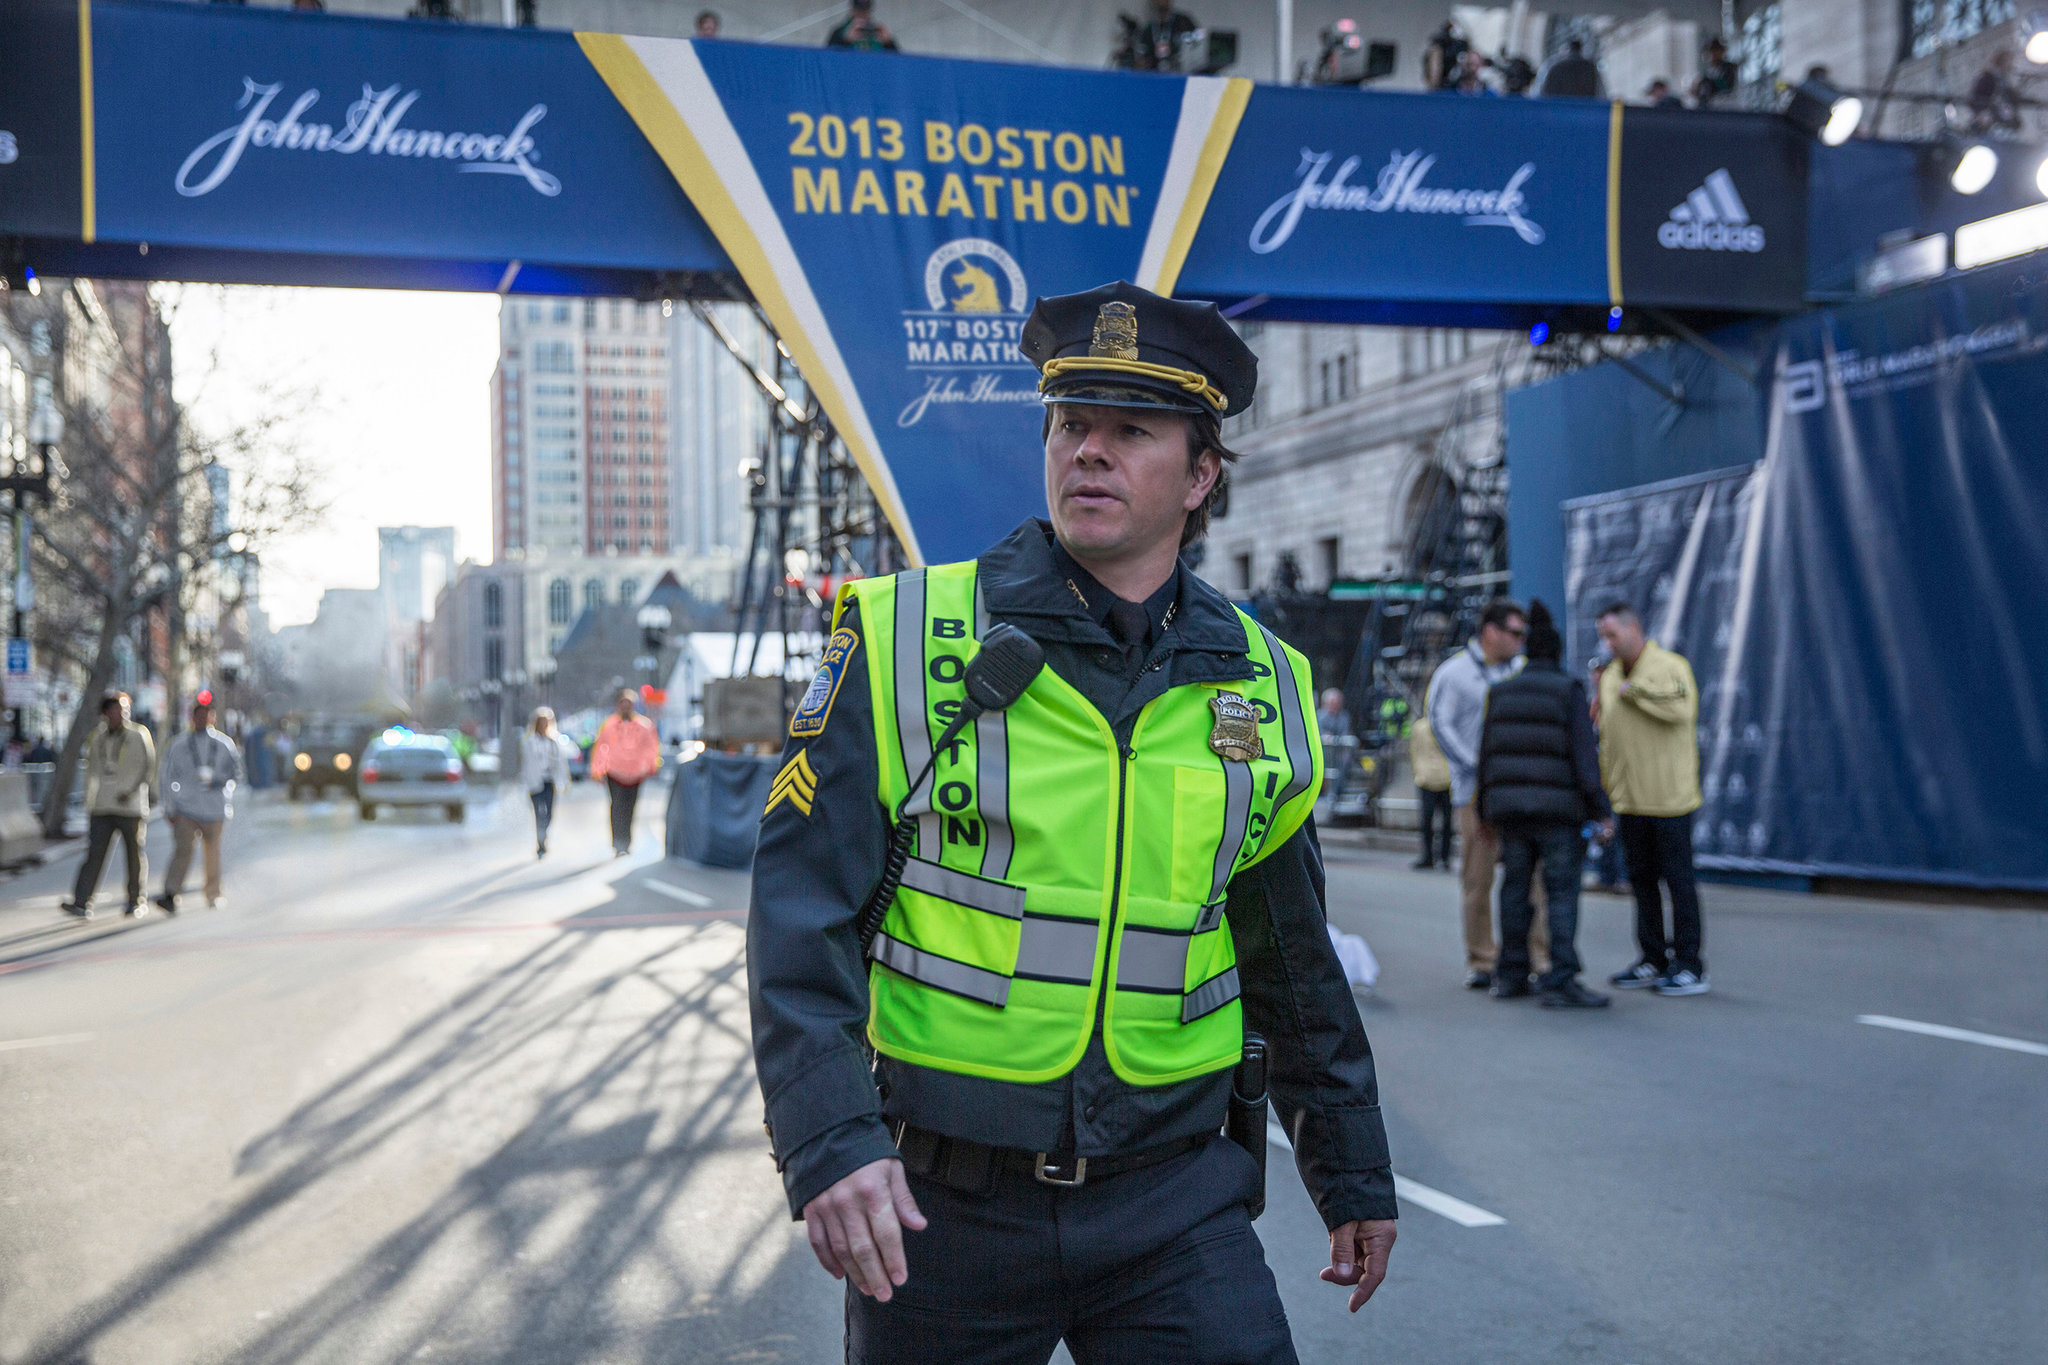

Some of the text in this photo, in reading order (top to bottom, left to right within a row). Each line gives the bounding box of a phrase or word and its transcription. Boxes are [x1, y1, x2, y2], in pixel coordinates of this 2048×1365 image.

[174, 76, 563, 198] John Hancock
[788, 112, 1125, 176] 2013 BOSTON
[792, 168, 1131, 227] MARATHON
[1248, 146, 1546, 255] John Hancock
[1657, 219, 1767, 254] adidas
[907, 341, 1030, 363] MARATH
[956, 320, 1026, 340] BOST
[897, 374, 964, 429] John
[930, 617, 981, 846] BOSTON
[1241, 661, 1280, 859] POLIC
